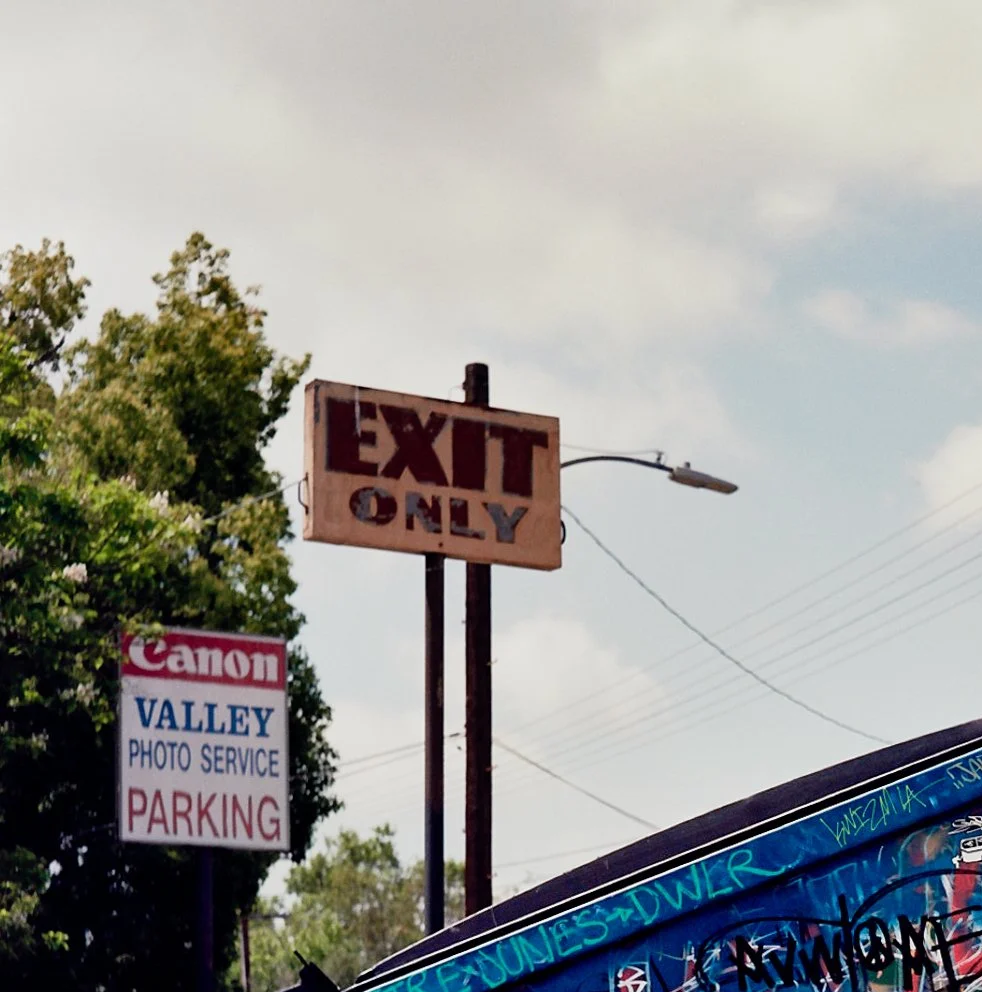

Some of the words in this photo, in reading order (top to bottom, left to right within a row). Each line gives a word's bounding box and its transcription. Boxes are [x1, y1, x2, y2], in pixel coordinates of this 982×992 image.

[326, 397, 549, 498] EXIT
[349, 486, 529, 544] ONLY
[128, 633, 278, 683] Canon
[134, 696, 275, 738] VALLEY
[129, 738, 192, 772] PHOTO
[200, 743, 280, 778] SERVICE
[128, 786, 281, 842] PARKING
